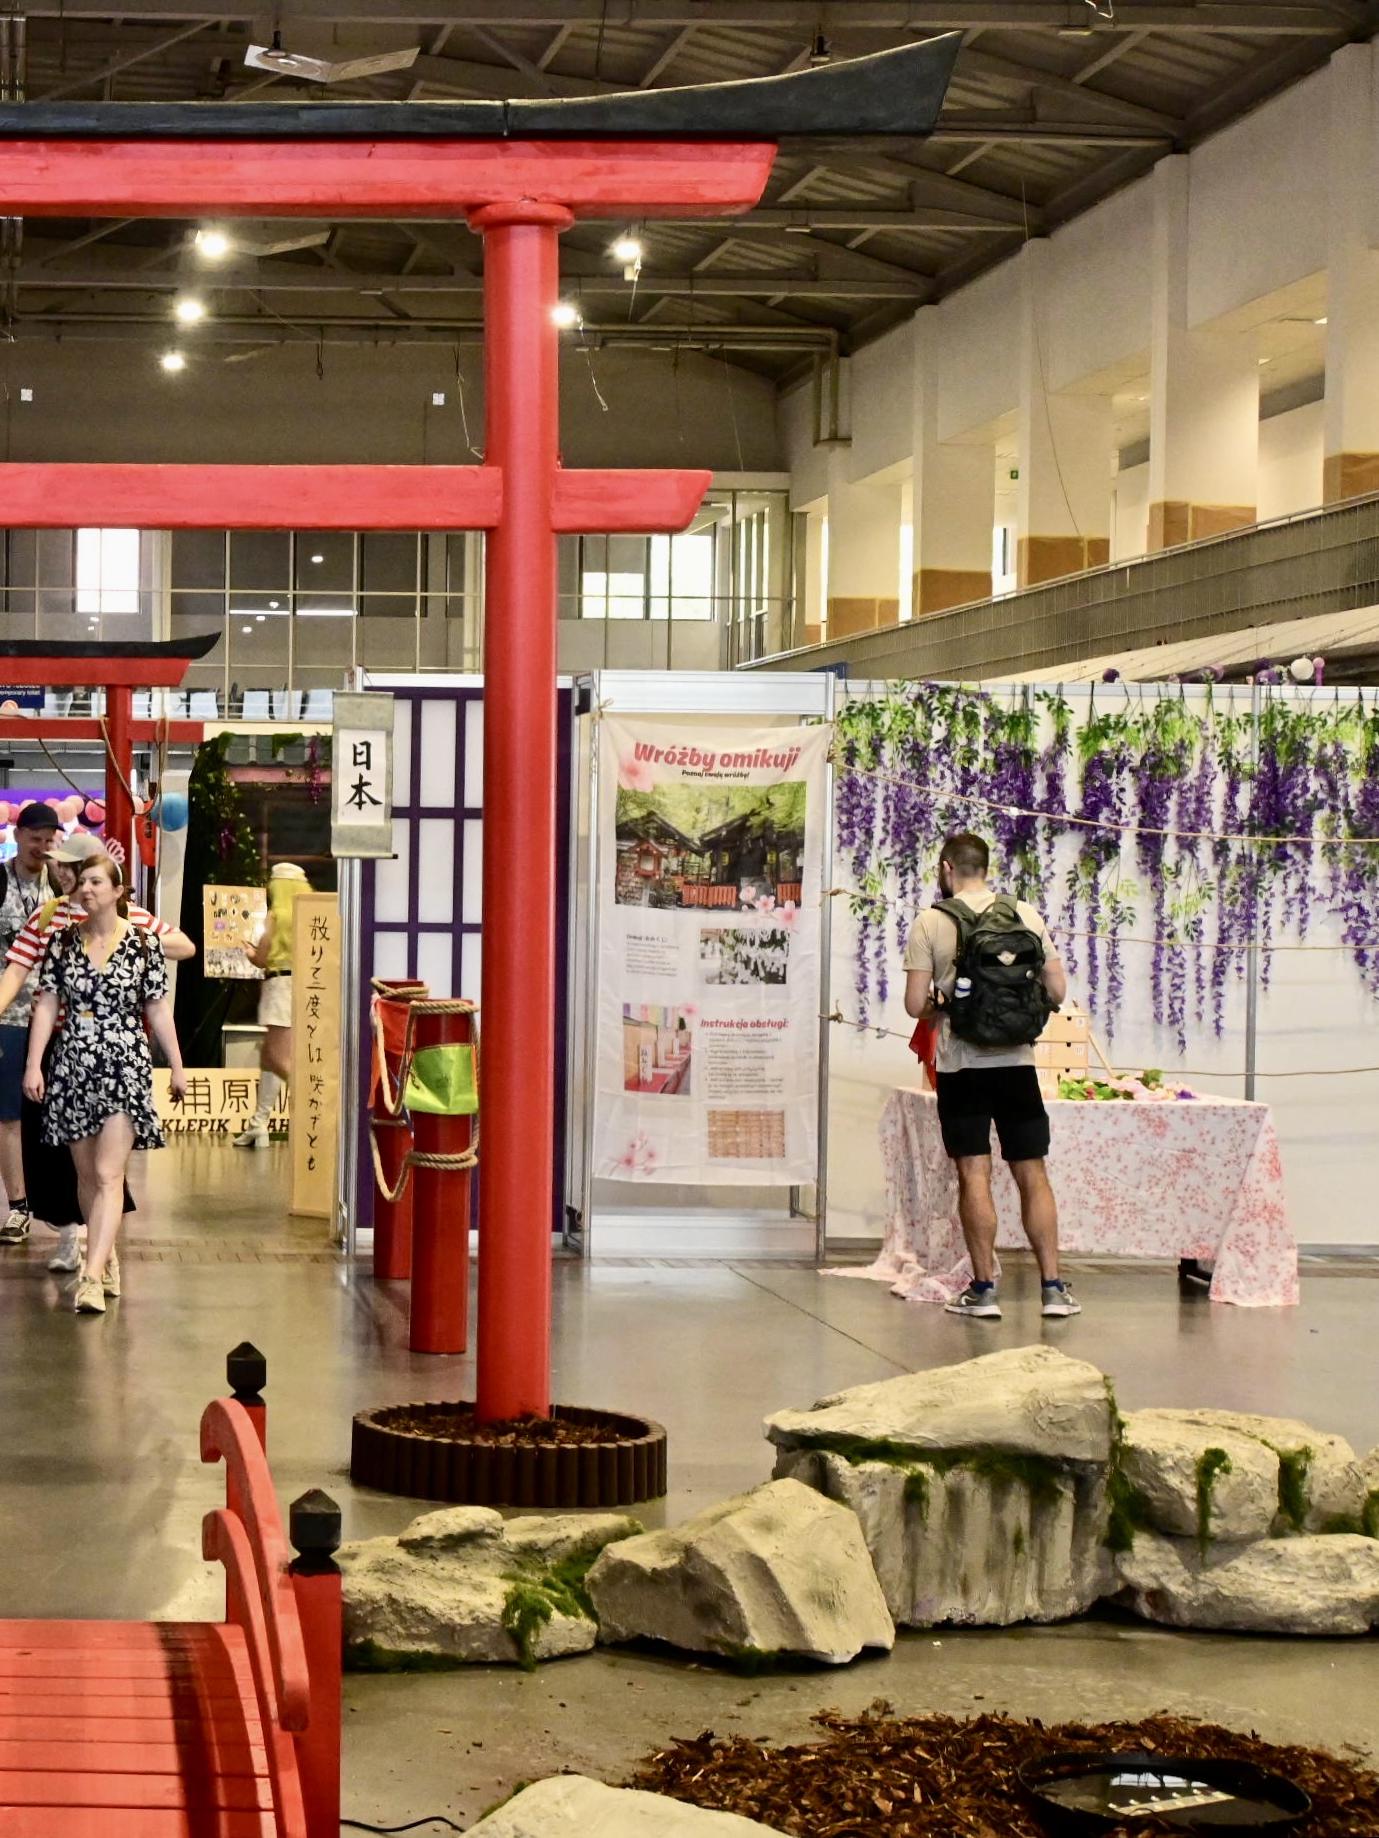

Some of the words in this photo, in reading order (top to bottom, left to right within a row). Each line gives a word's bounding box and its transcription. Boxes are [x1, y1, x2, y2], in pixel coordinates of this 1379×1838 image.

[634, 742, 716, 772] Wróżby
[720, 747, 802, 772] omikuji
[345, 740, 383, 811] 日本
[701, 1018, 748, 1030] Instrukcja
[750, 1018, 789, 1030] obsługi:
[161, 1118, 230, 1133] KLEPIK
